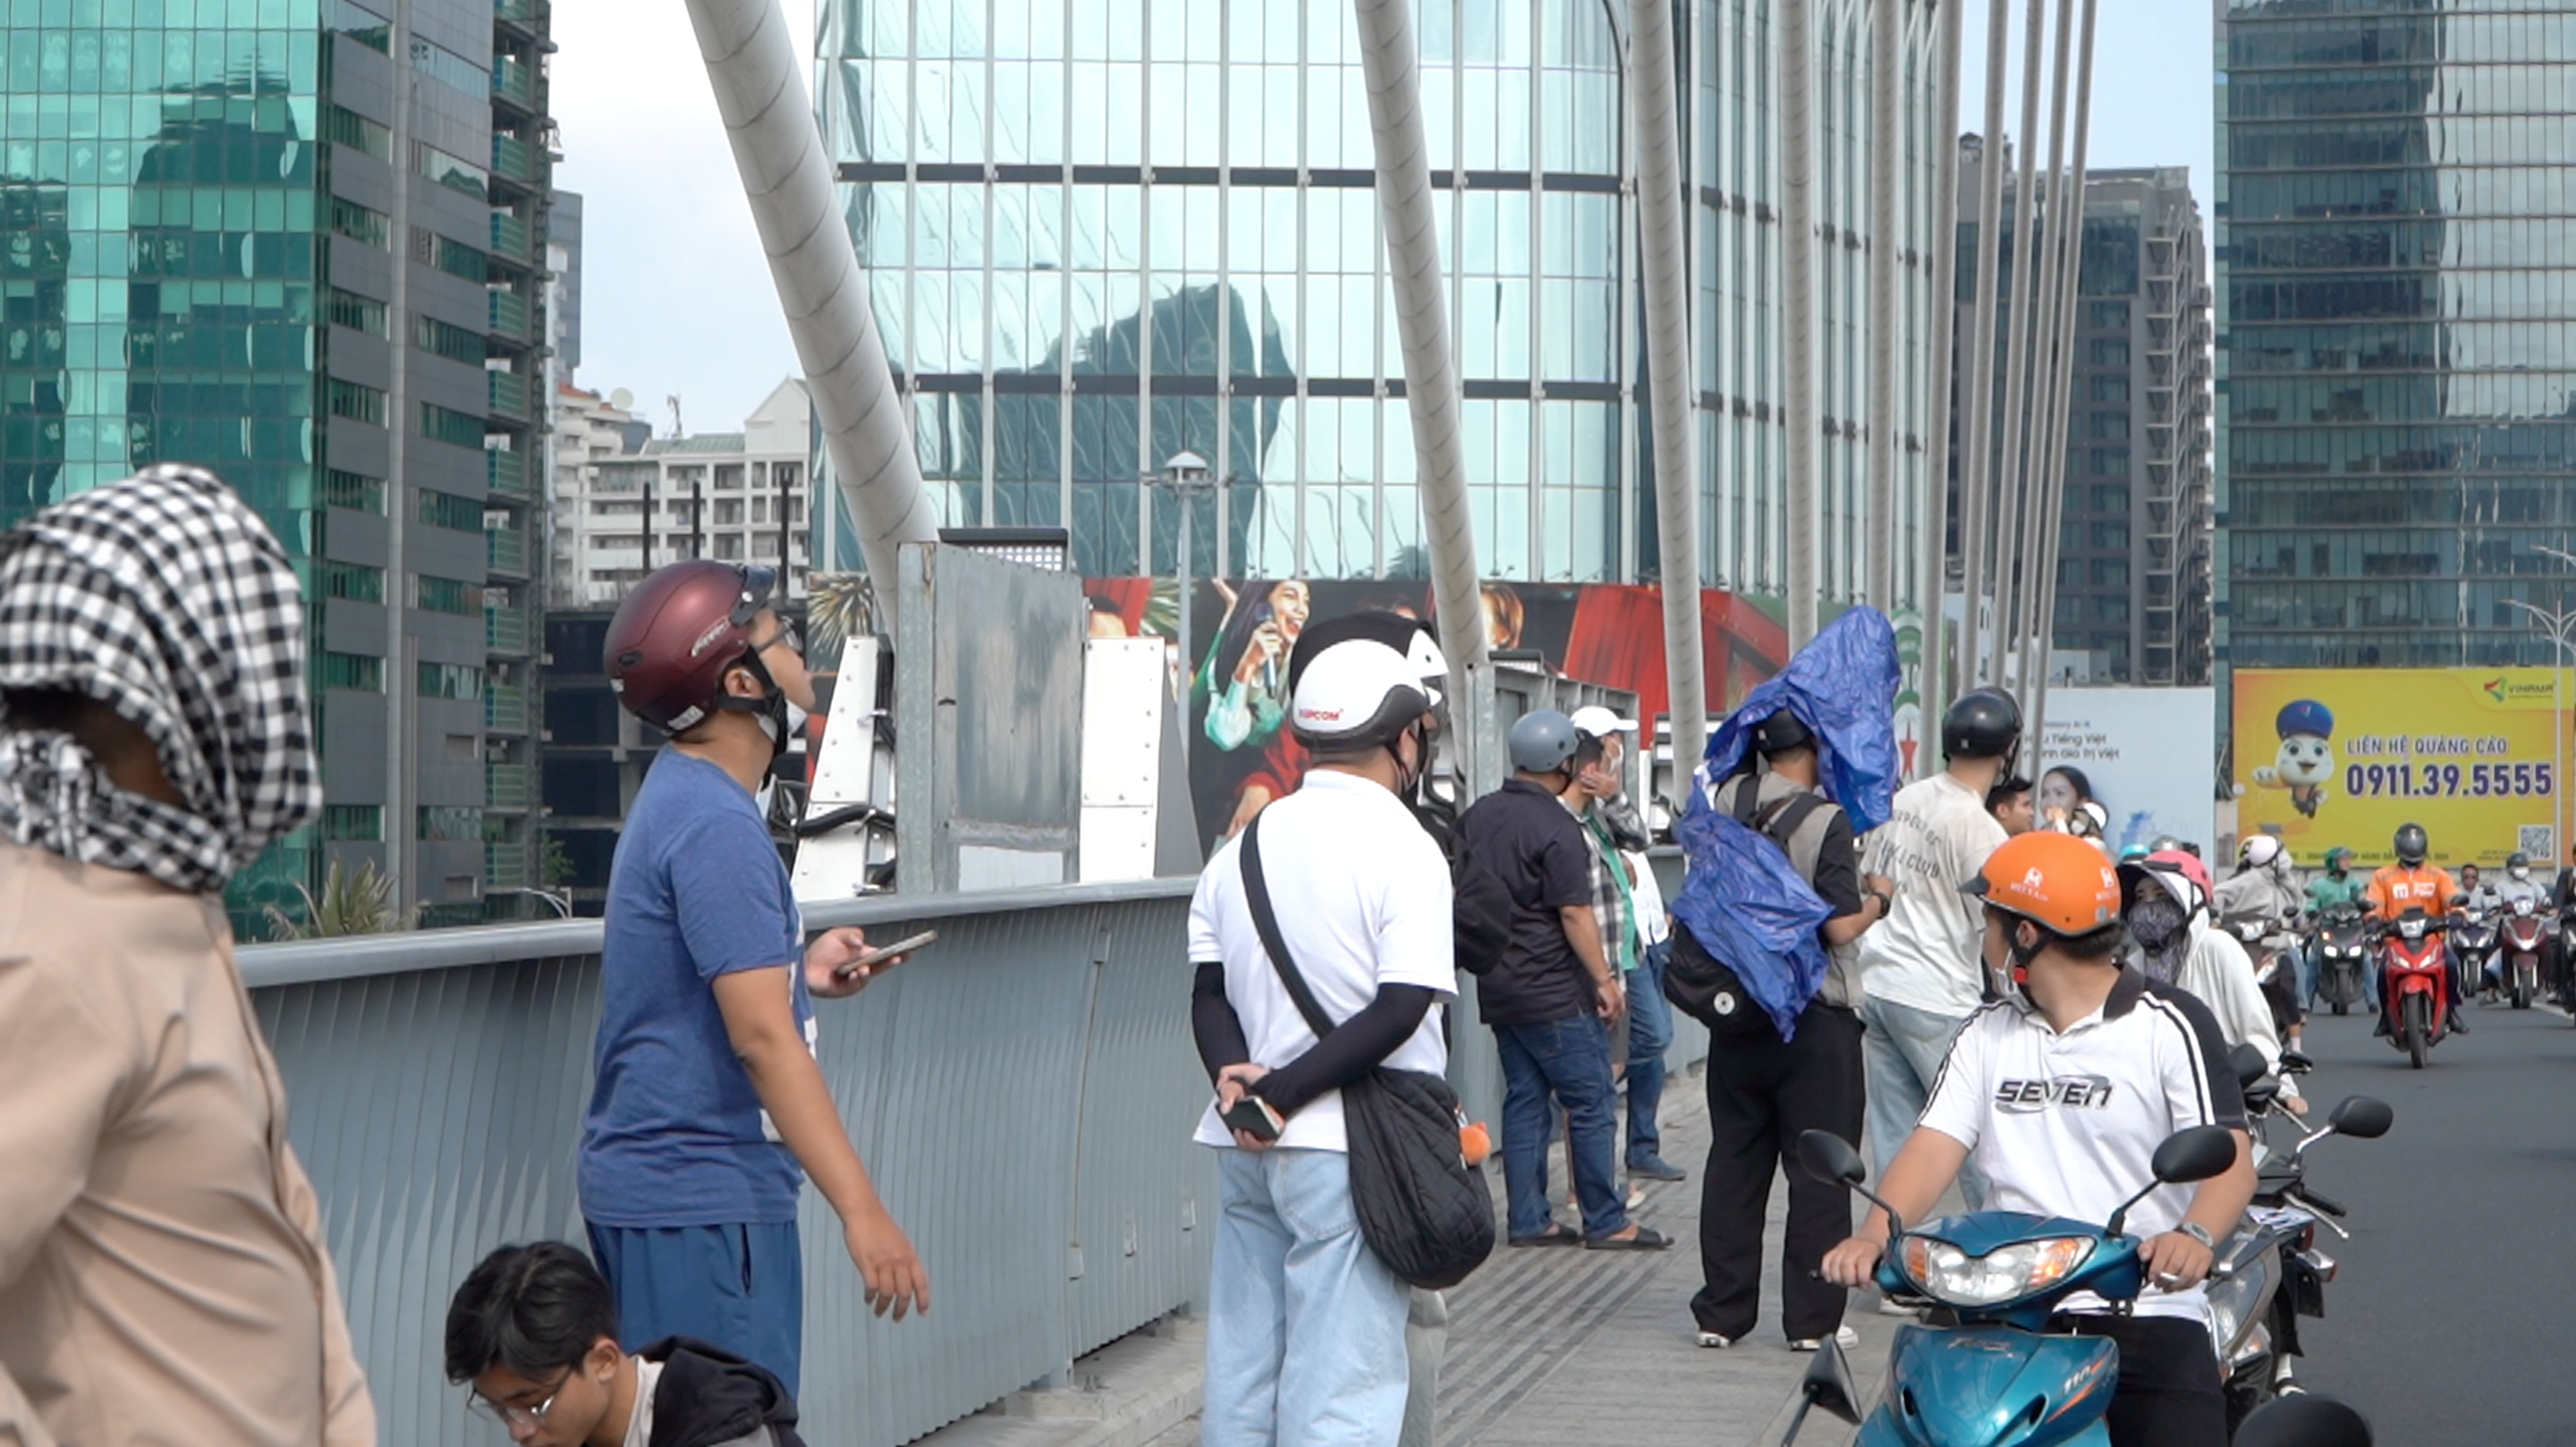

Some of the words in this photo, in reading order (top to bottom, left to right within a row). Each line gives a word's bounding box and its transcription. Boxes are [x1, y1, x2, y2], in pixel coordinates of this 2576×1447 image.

[2346, 735, 2383, 754] LIÊN
[2388, 733, 2409, 758] HỆ
[2414, 734, 2470, 754] QUẢNG
[2475, 733, 2508, 754] CÁO
[2345, 763, 2553, 796] 0911.39.5555
